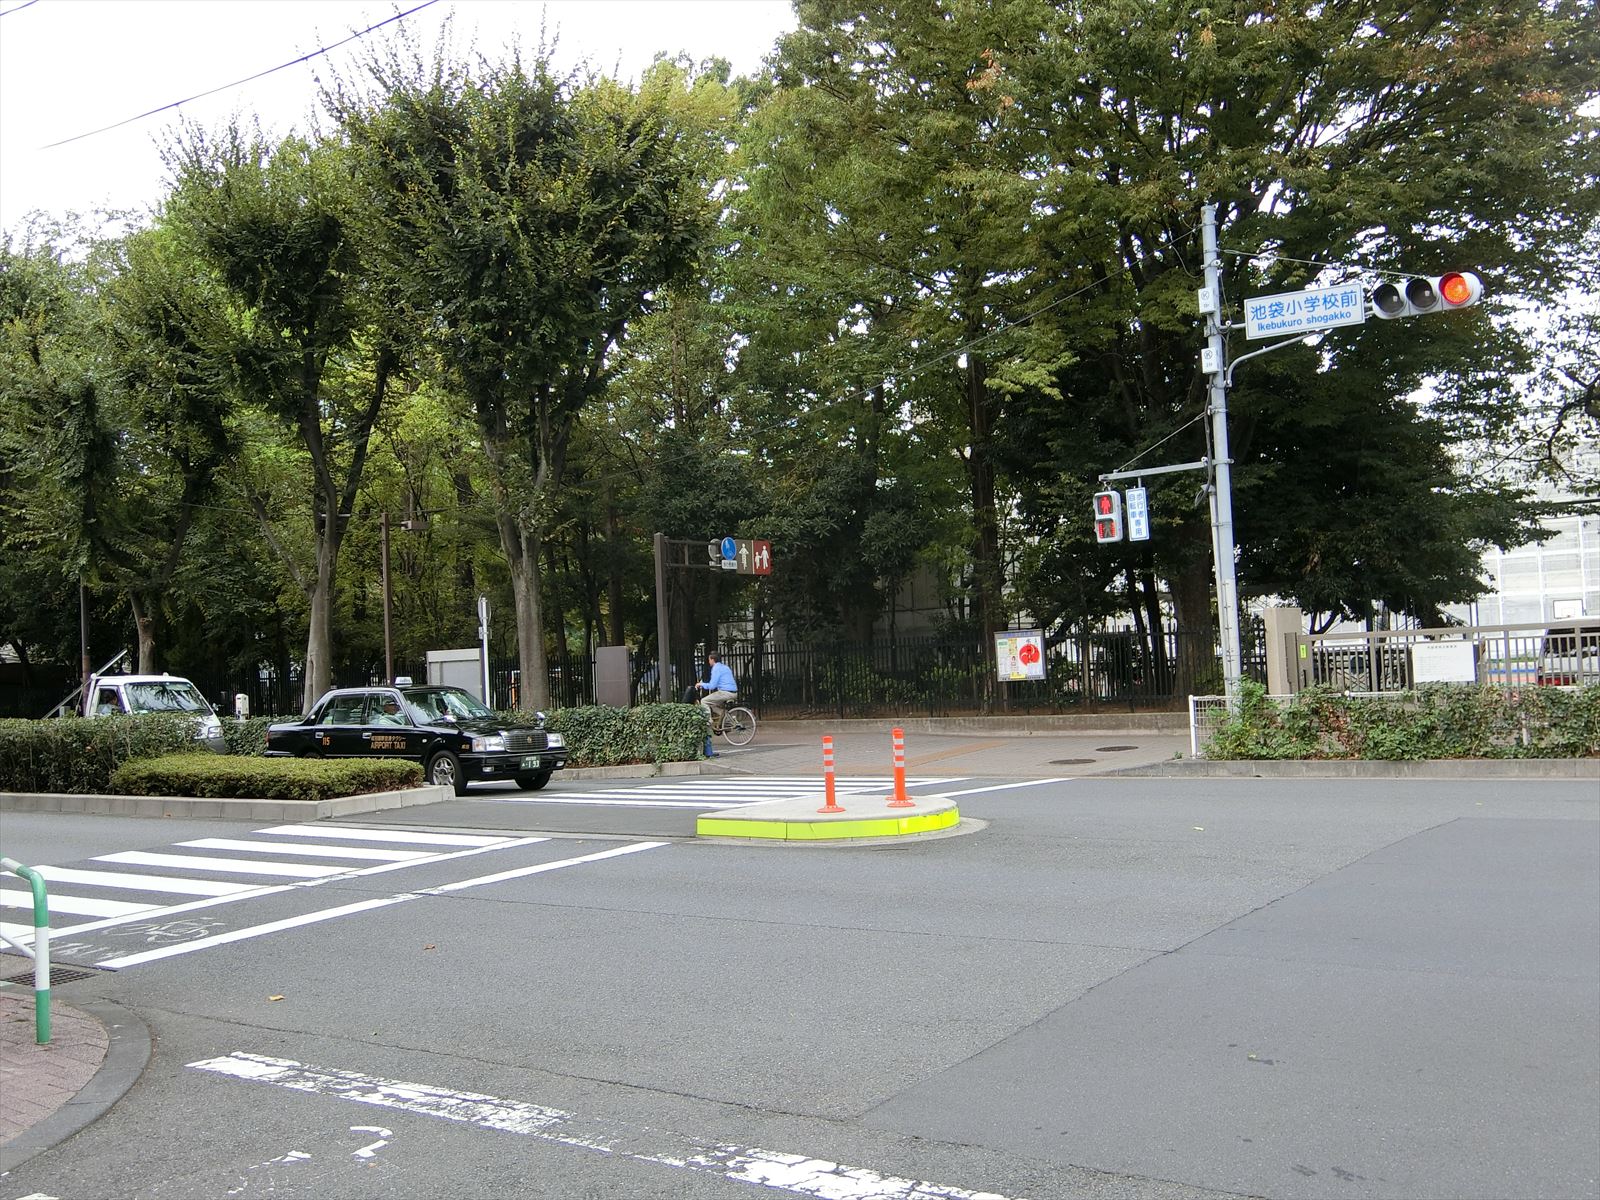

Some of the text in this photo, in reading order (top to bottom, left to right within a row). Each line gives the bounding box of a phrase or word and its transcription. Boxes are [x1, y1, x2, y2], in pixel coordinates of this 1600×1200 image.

[1251, 290, 1357, 321] 池袋小学校前
[1257, 310, 1351, 331] Ikebukuro shogakko
[322, 736, 330, 746] 115
[371, 741, 406, 749] AIRPORT TAXI
